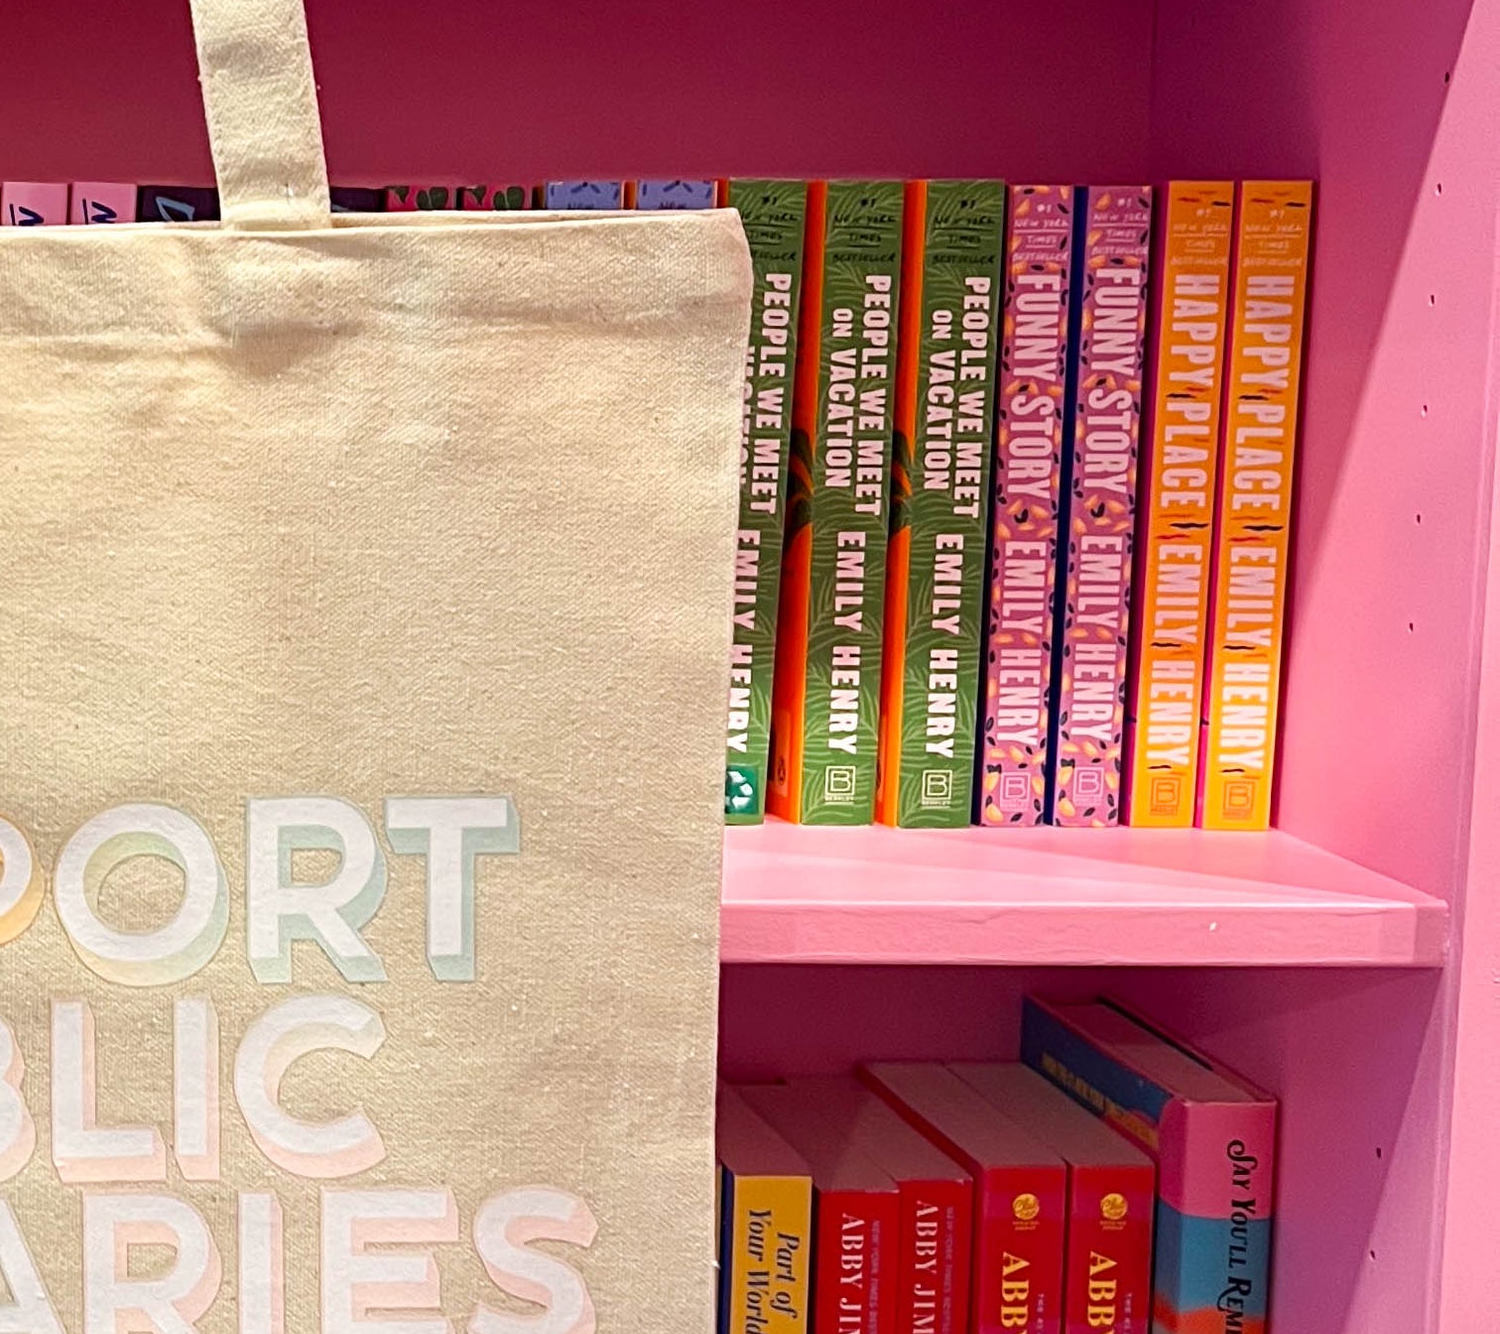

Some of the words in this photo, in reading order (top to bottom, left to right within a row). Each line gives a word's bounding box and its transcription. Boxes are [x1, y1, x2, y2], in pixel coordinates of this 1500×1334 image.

[932, 310, 952, 340] ON
[960, 277, 991, 377] PEOPLE
[1013, 271, 1060, 381] FUNNY
[1240, 277, 1293, 391] HAPPY
[923, 350, 956, 492] VACATION
[957, 391, 985, 432] WE
[1005, 395, 1054, 502] STORY
[1233, 406, 1286, 510] PLACE
[953, 442, 980, 517] MEET
[933, 533, 964, 636] EMILY
[1226, 546, 1276, 648] EMILY
[926, 649, 959, 758] HENRY
[1220, 664, 1268, 769] HENRY
[746, 1210, 773, 1264] Your
[777, 1232, 801, 1284] Part
[769, 1294, 797, 1318] of
